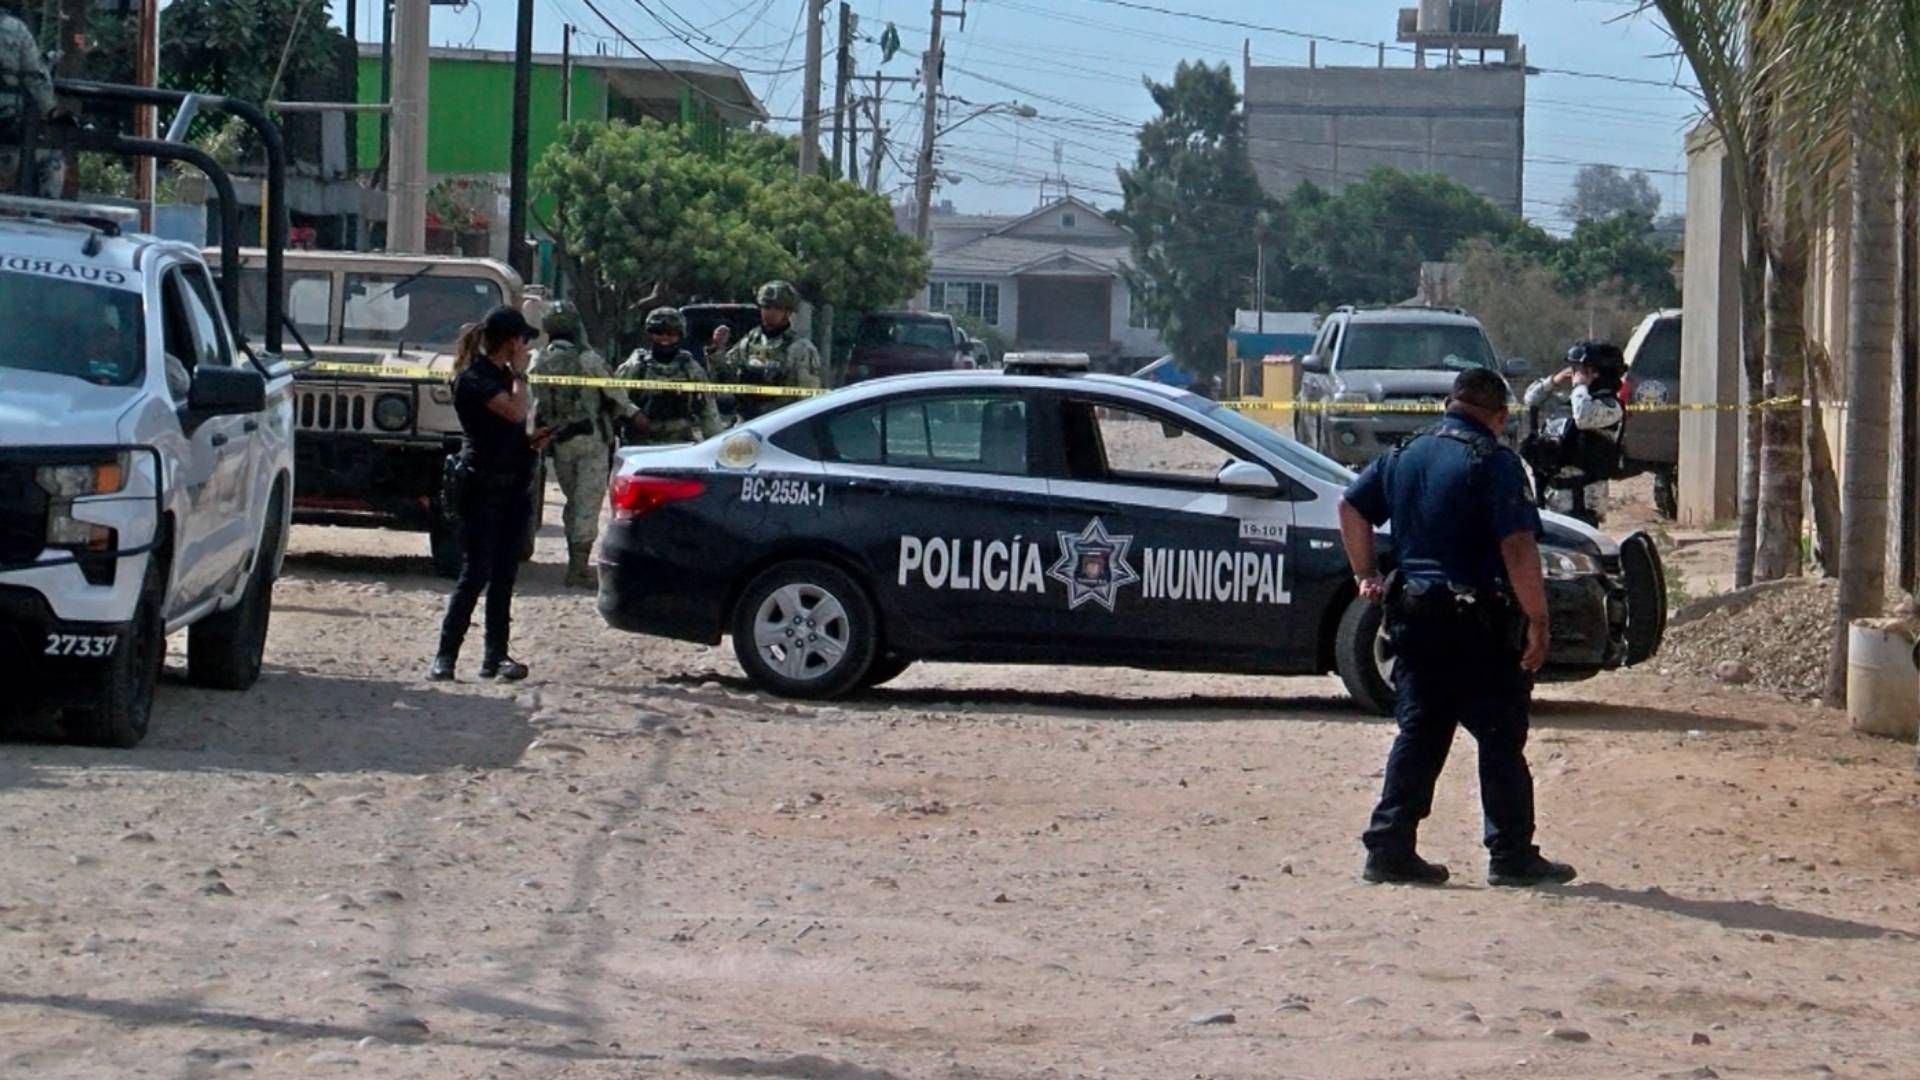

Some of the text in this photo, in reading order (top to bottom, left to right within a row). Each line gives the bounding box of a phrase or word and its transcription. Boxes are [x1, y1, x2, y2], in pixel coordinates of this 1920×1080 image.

[741, 477, 825, 506] BC-255A-1
[1243, 524, 1283, 537] 19-101
[898, 534, 1291, 604] POLICÍA MUNICIPAL
[44, 632, 117, 656] 27337
